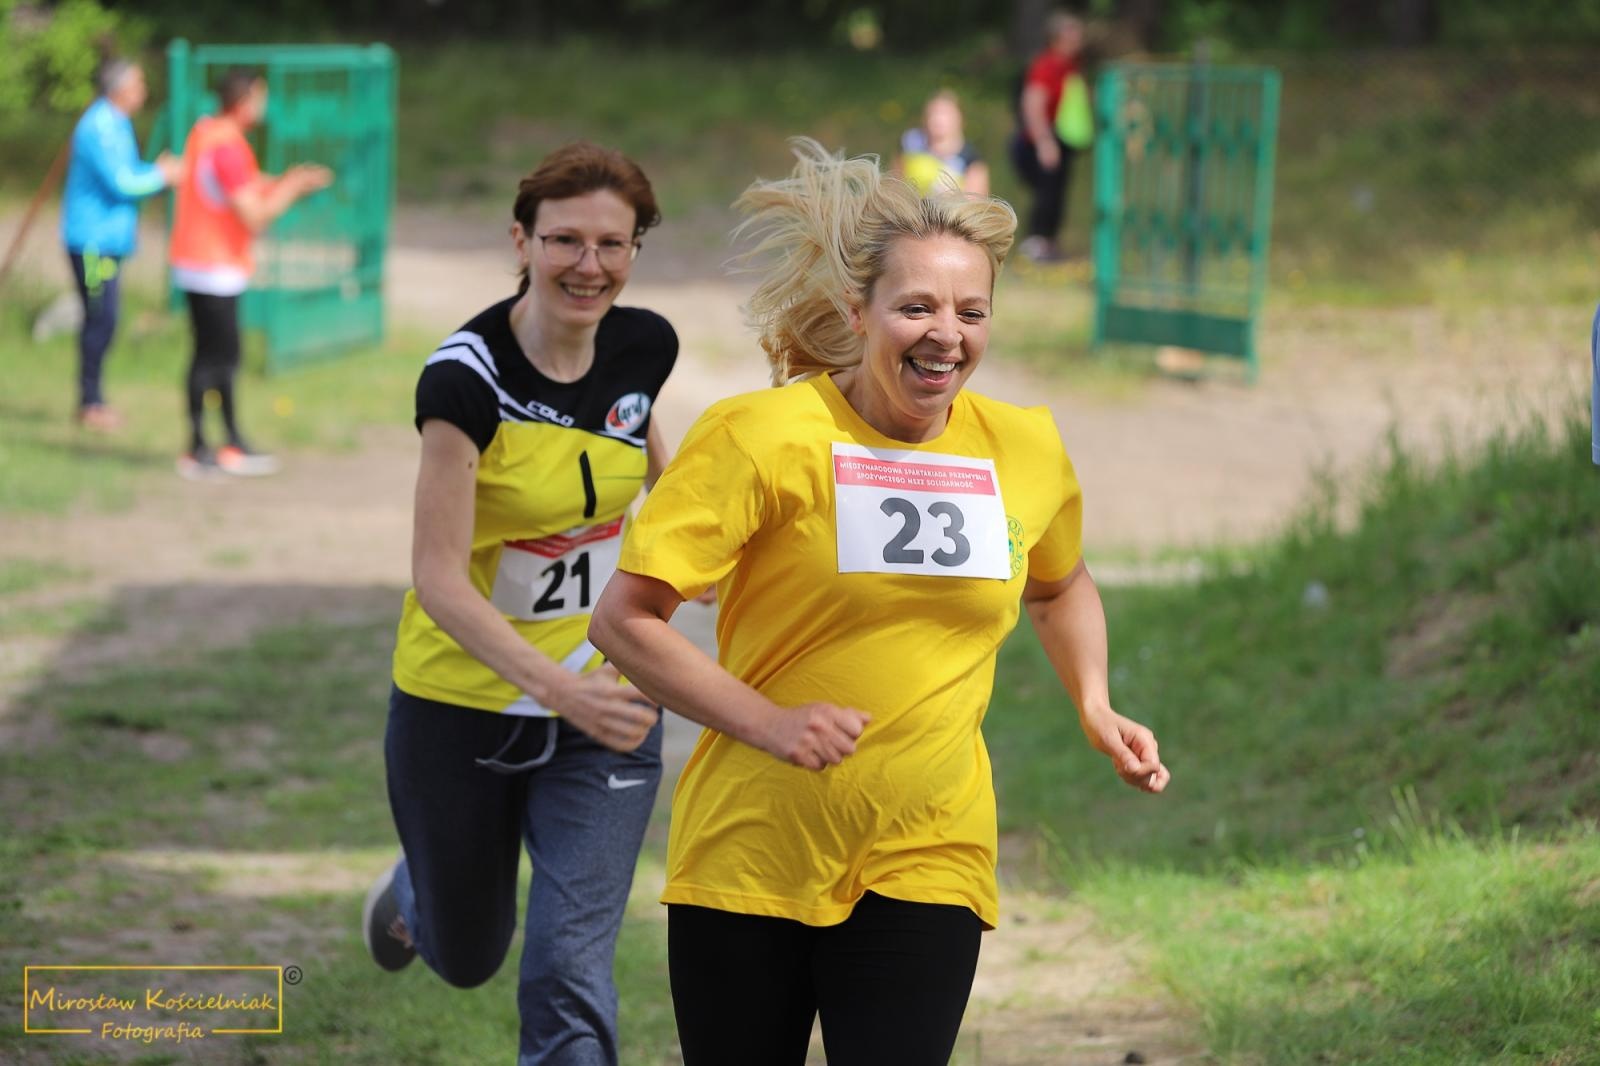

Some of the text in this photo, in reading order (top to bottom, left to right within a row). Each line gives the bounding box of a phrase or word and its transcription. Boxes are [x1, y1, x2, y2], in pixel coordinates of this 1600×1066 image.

[904, 467, 947, 479] SPARTAKIADA
[879, 497, 971, 567] 23
[532, 551, 590, 614] 21
